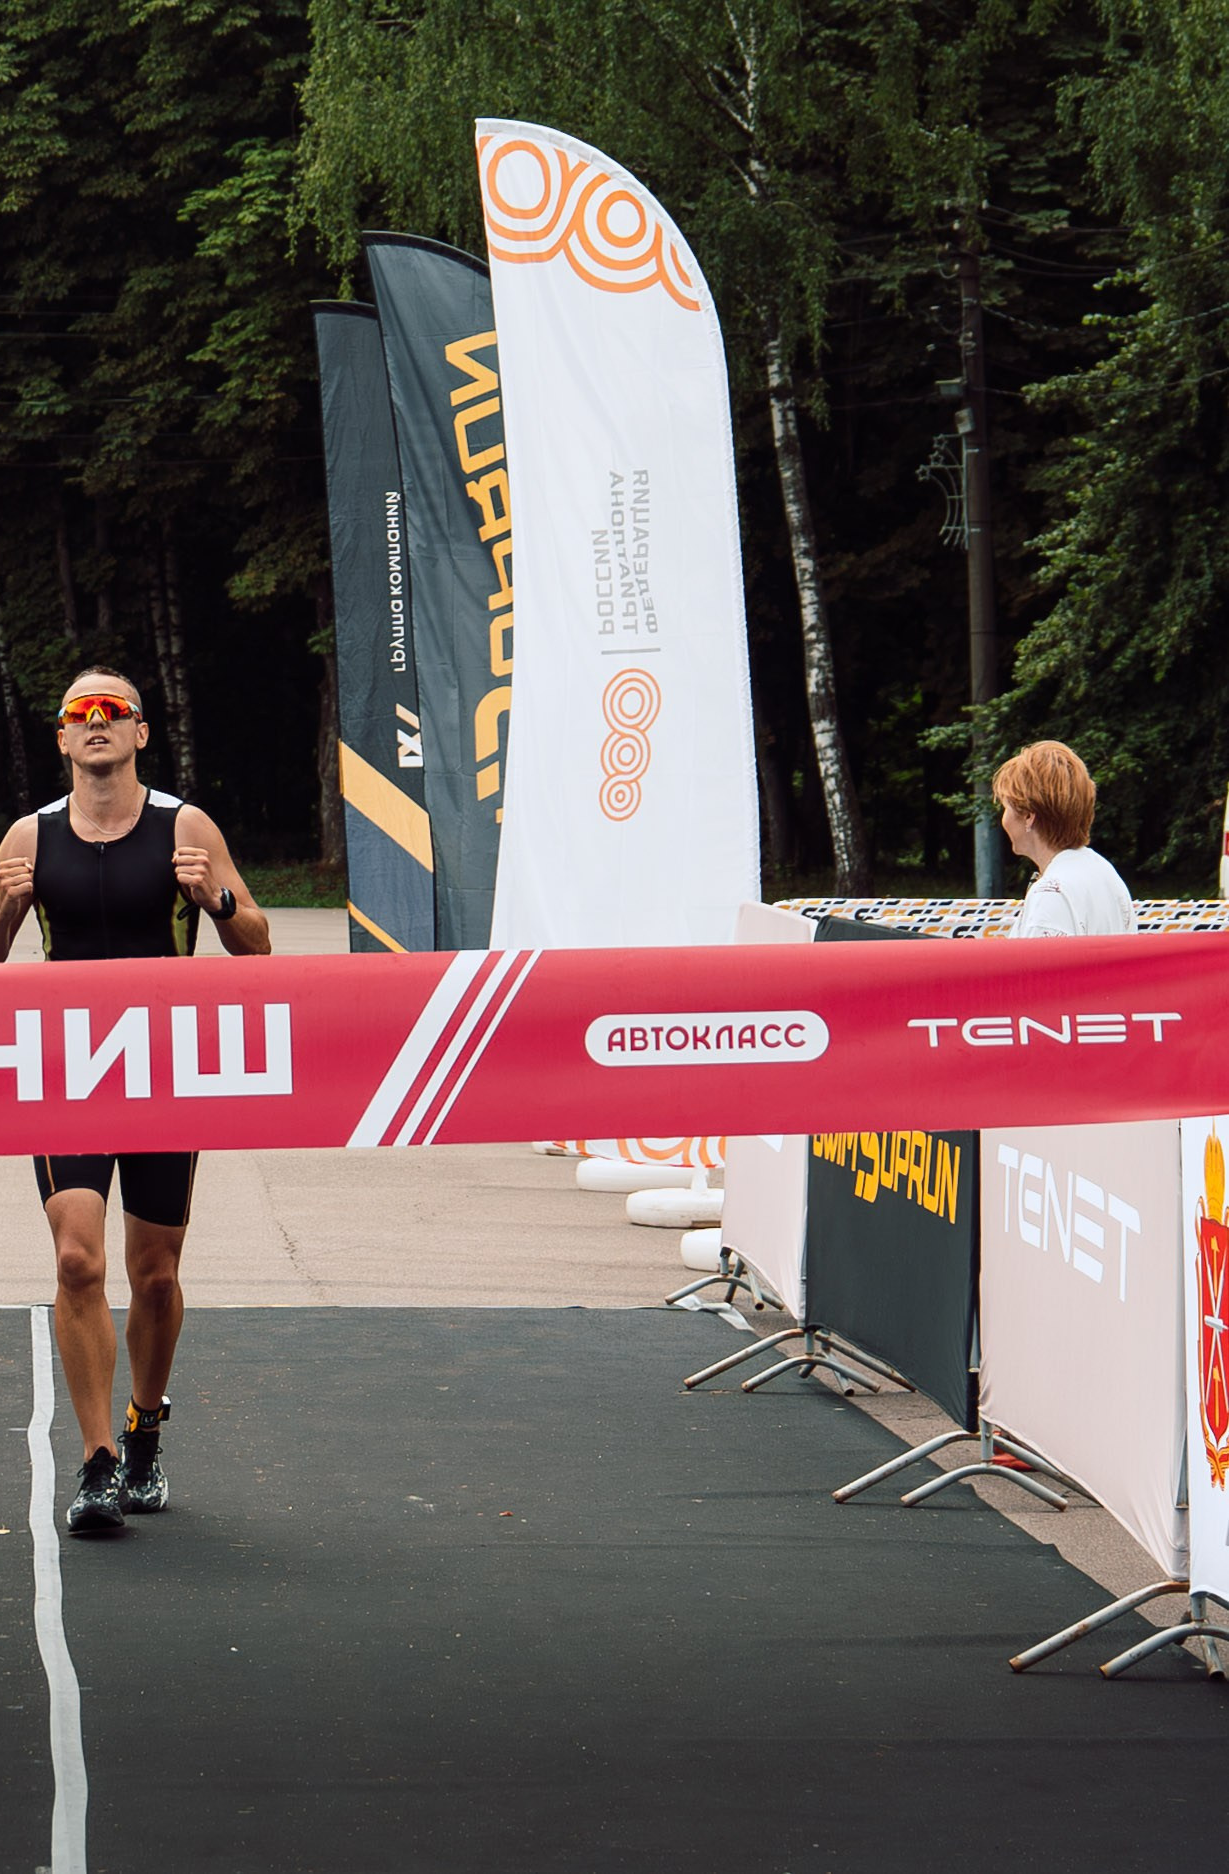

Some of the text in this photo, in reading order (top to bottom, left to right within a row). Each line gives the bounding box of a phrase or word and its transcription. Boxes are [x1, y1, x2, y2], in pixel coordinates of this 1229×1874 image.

[606, 1022, 807, 1053] АВТОКЛАСС
[907, 1012, 1182, 1047] TENET
[997, 1143, 1142, 1303] TENET
